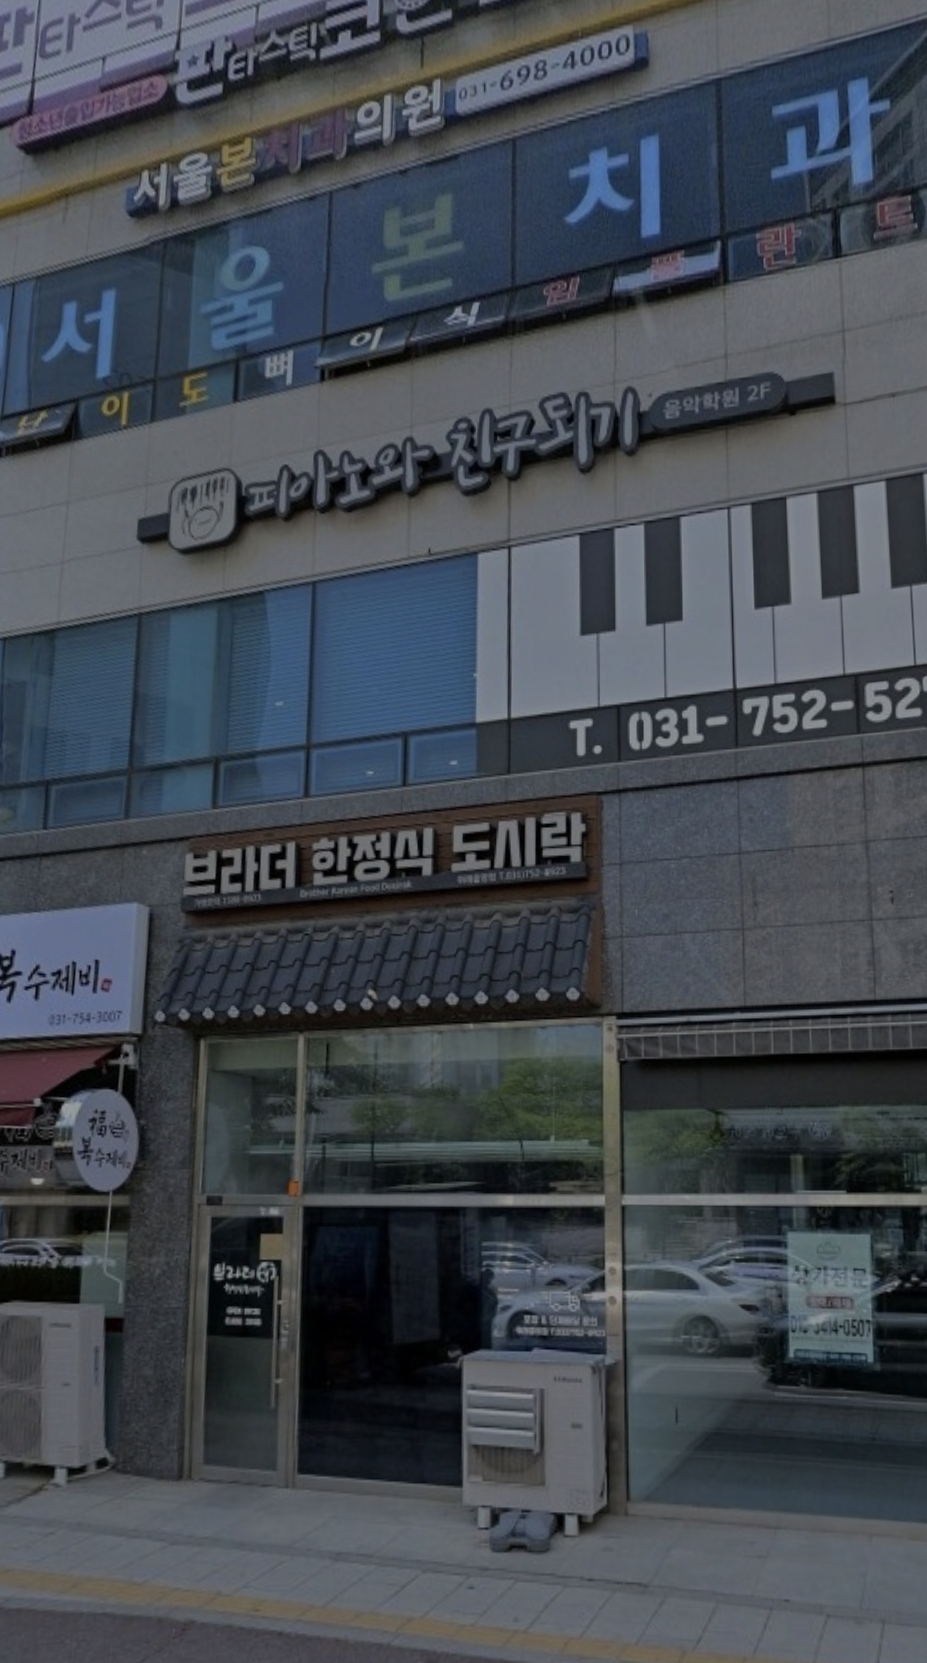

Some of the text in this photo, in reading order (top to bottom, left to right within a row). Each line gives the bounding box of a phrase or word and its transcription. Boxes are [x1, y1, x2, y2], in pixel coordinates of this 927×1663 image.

[172, 22, 326, 106] 판타스틱
[132, 33, 631, 212] 서울본치과의원 031-698-4000
[245, 381, 773, 520] 피아노와 친구되기 음악학원 2F
[183, 811, 587, 897] 브라더 한정식 도시락
